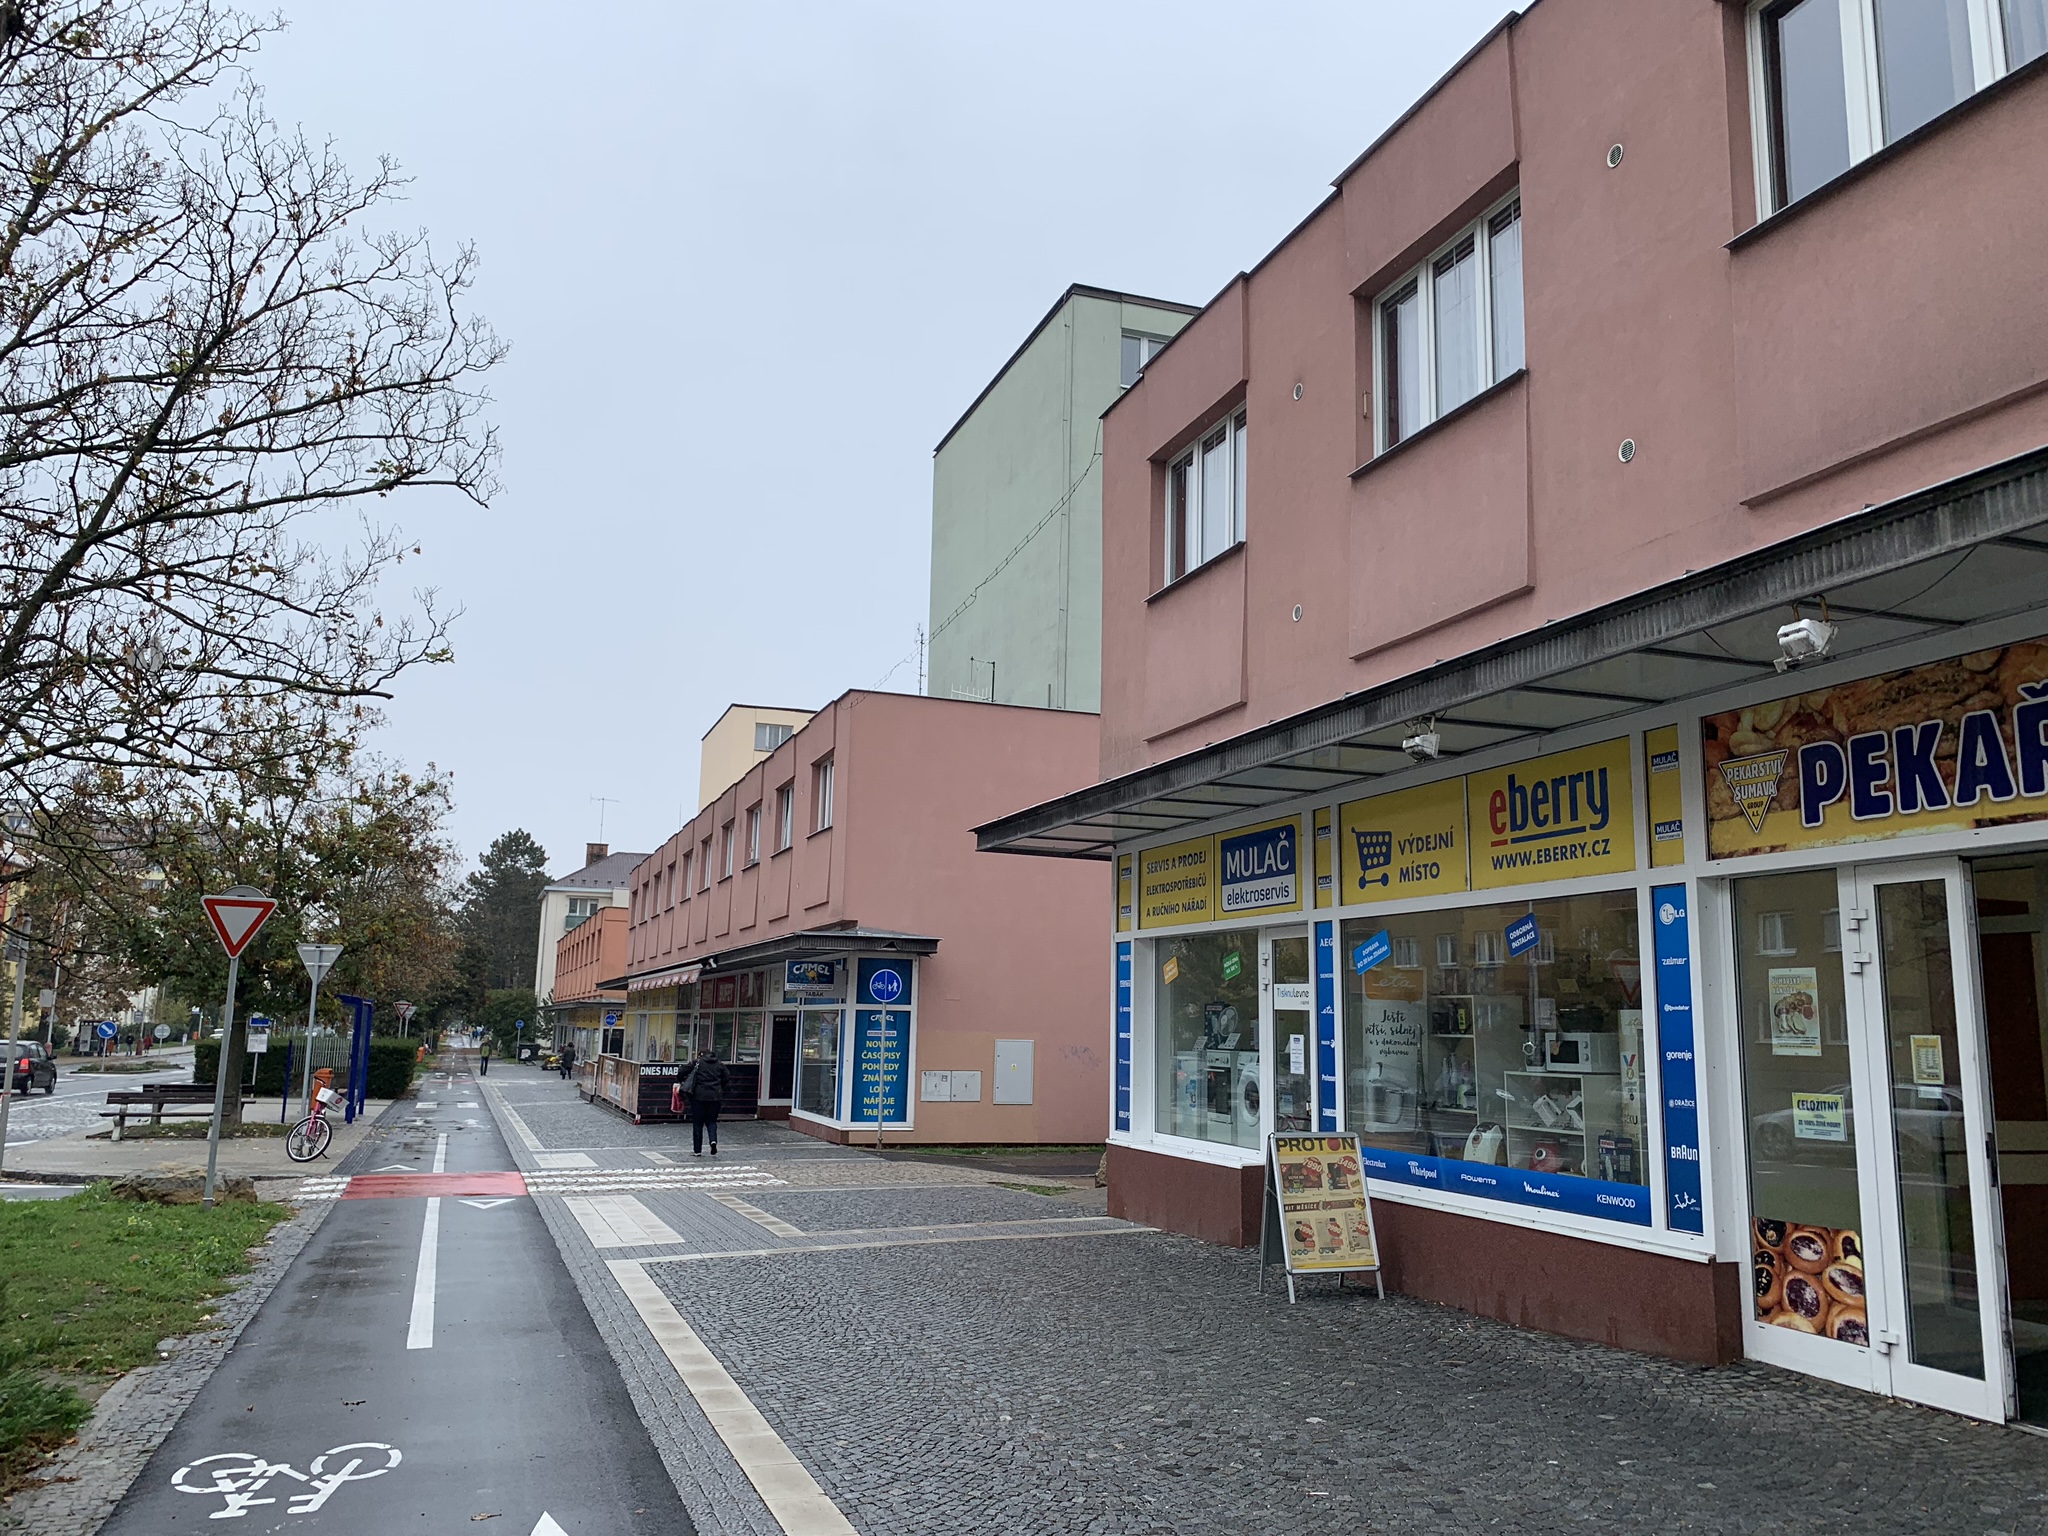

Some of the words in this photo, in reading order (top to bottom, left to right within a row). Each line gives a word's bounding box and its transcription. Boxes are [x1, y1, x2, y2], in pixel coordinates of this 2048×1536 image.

[1653, 752, 1677, 766] MULAČ
[1727, 755, 1782, 782] PEKAŘSTVÍ
[1734, 781, 1776, 801] ŠUMAVA
[1489, 767, 1610, 835] eberry
[1656, 821, 1681, 834] MULAČ
[1397, 826, 1454, 856] VÝDEJNÍ
[1227, 831, 1290, 880] MULAČ
[1491, 838, 1611, 870] WWW.EBERRY.CZ
[1147, 859, 1170, 875] SERVIS
[1171, 857, 1177, 870] A
[1178, 850, 1206, 868] PRODEJ
[1399, 861, 1441, 884] MÍSTO
[1146, 872, 1207, 896] ELEKTROSPOTŘEBIČŮ
[1227, 882, 1290, 906] elektroservis
[1146, 907, 1151, 918] A
[1152, 901, 1180, 917] RUČNÍHO
[1181, 896, 1207, 913] NÁŘADÍ
[1674, 908, 1686, 918] LG
[1510, 920, 1533, 940] ODBORNÁ
[1320, 938, 1333, 947] AEG
[1511, 931, 1536, 949] INSTALACE
[793, 963, 830, 976] CAMEL
[870, 1014, 895, 1022] CAEL
[1381, 1009, 1407, 1023] Ještě
[1666, 1050, 1693, 1061] gorenje
[640, 1066, 661, 1076] DNES
[862, 1063, 900, 1071] POHEDY
[862, 1108, 895, 1117] TABKY
[1797, 1097, 1839, 1113] CELOŽITNÝ
[1670, 1145, 1698, 1161] BRAUN
[1362, 1156, 1387, 1169] Electrolux
[1410, 1165, 1437, 1179] Whirlpool
[1523, 1181, 1560, 1198] Moulinex
[1596, 1193, 1636, 1209] KENWOOD
